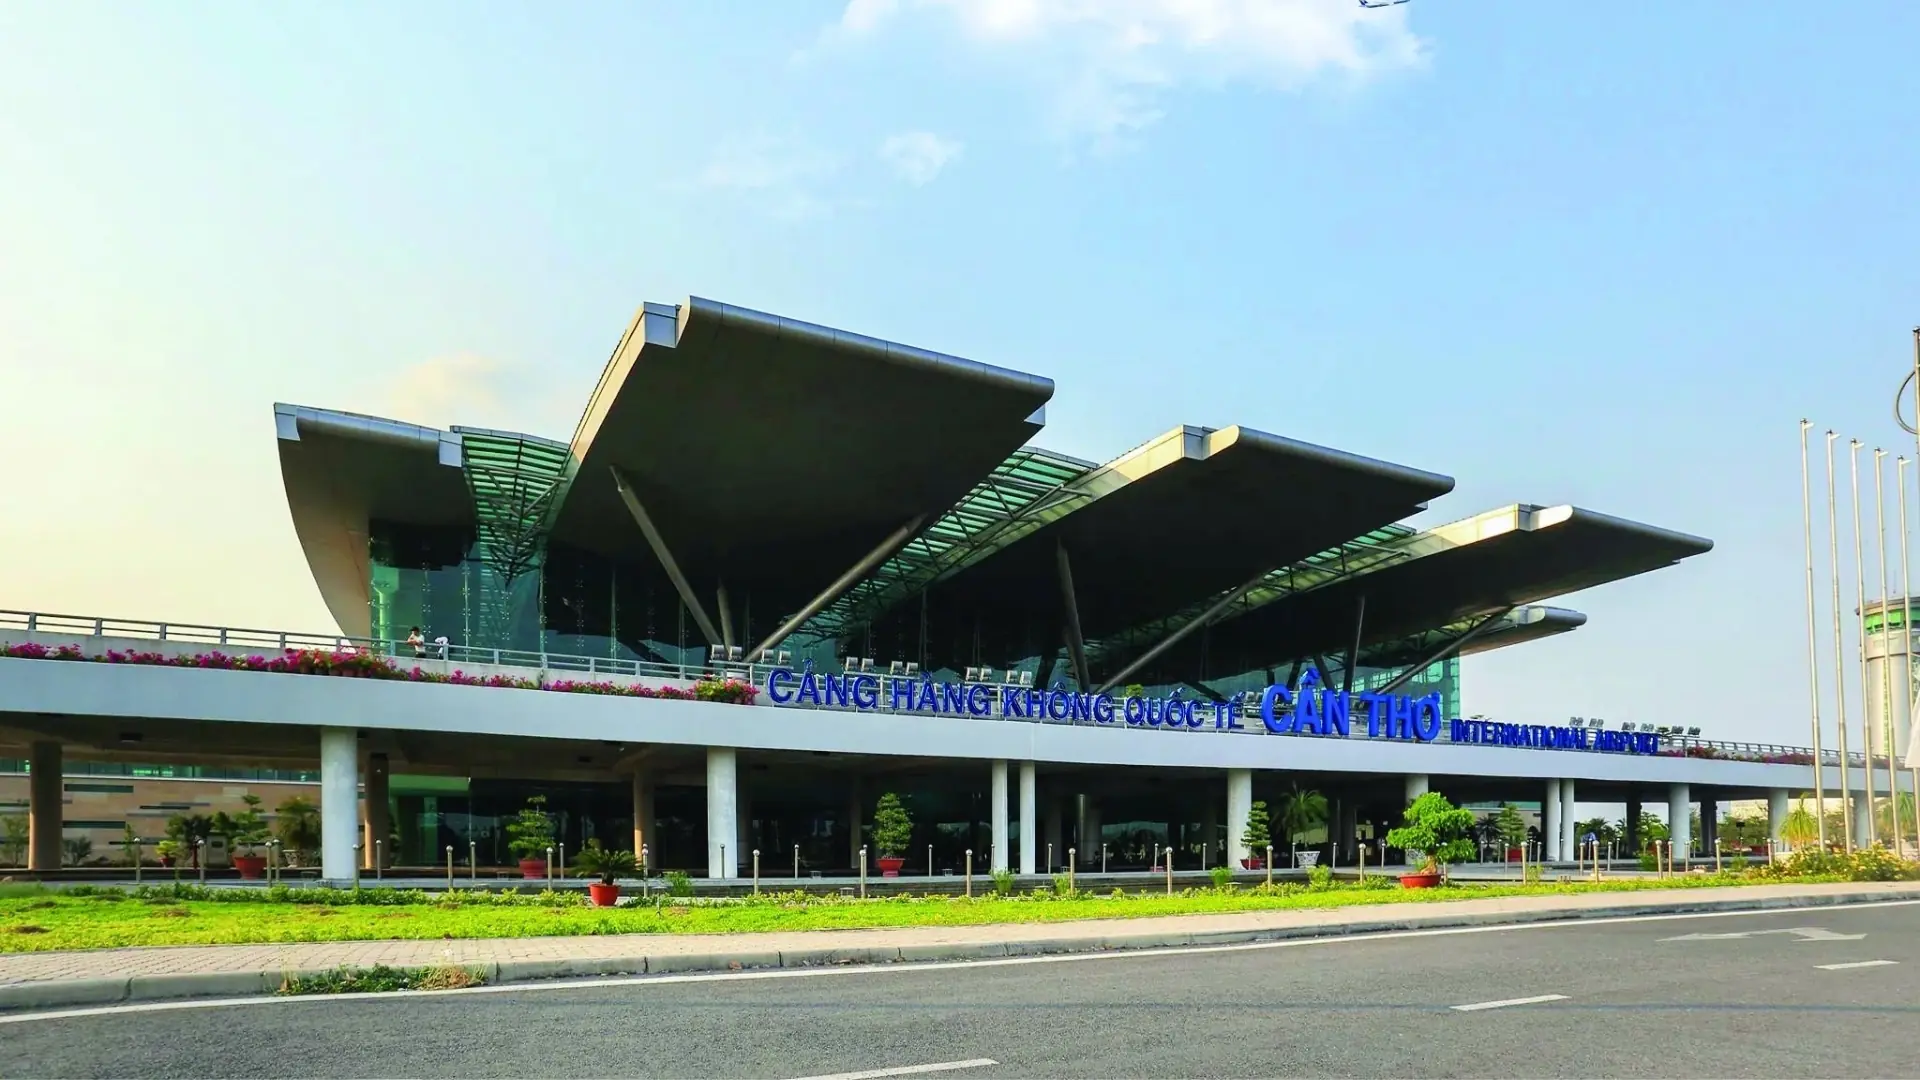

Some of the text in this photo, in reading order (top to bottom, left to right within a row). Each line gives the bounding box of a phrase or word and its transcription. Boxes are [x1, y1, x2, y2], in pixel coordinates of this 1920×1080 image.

[768, 657, 1660, 755] CẢNG HÀNG KHÔNG QUỐC TẾ CẦN THƠ INTERNATIONAL AIRPORT
